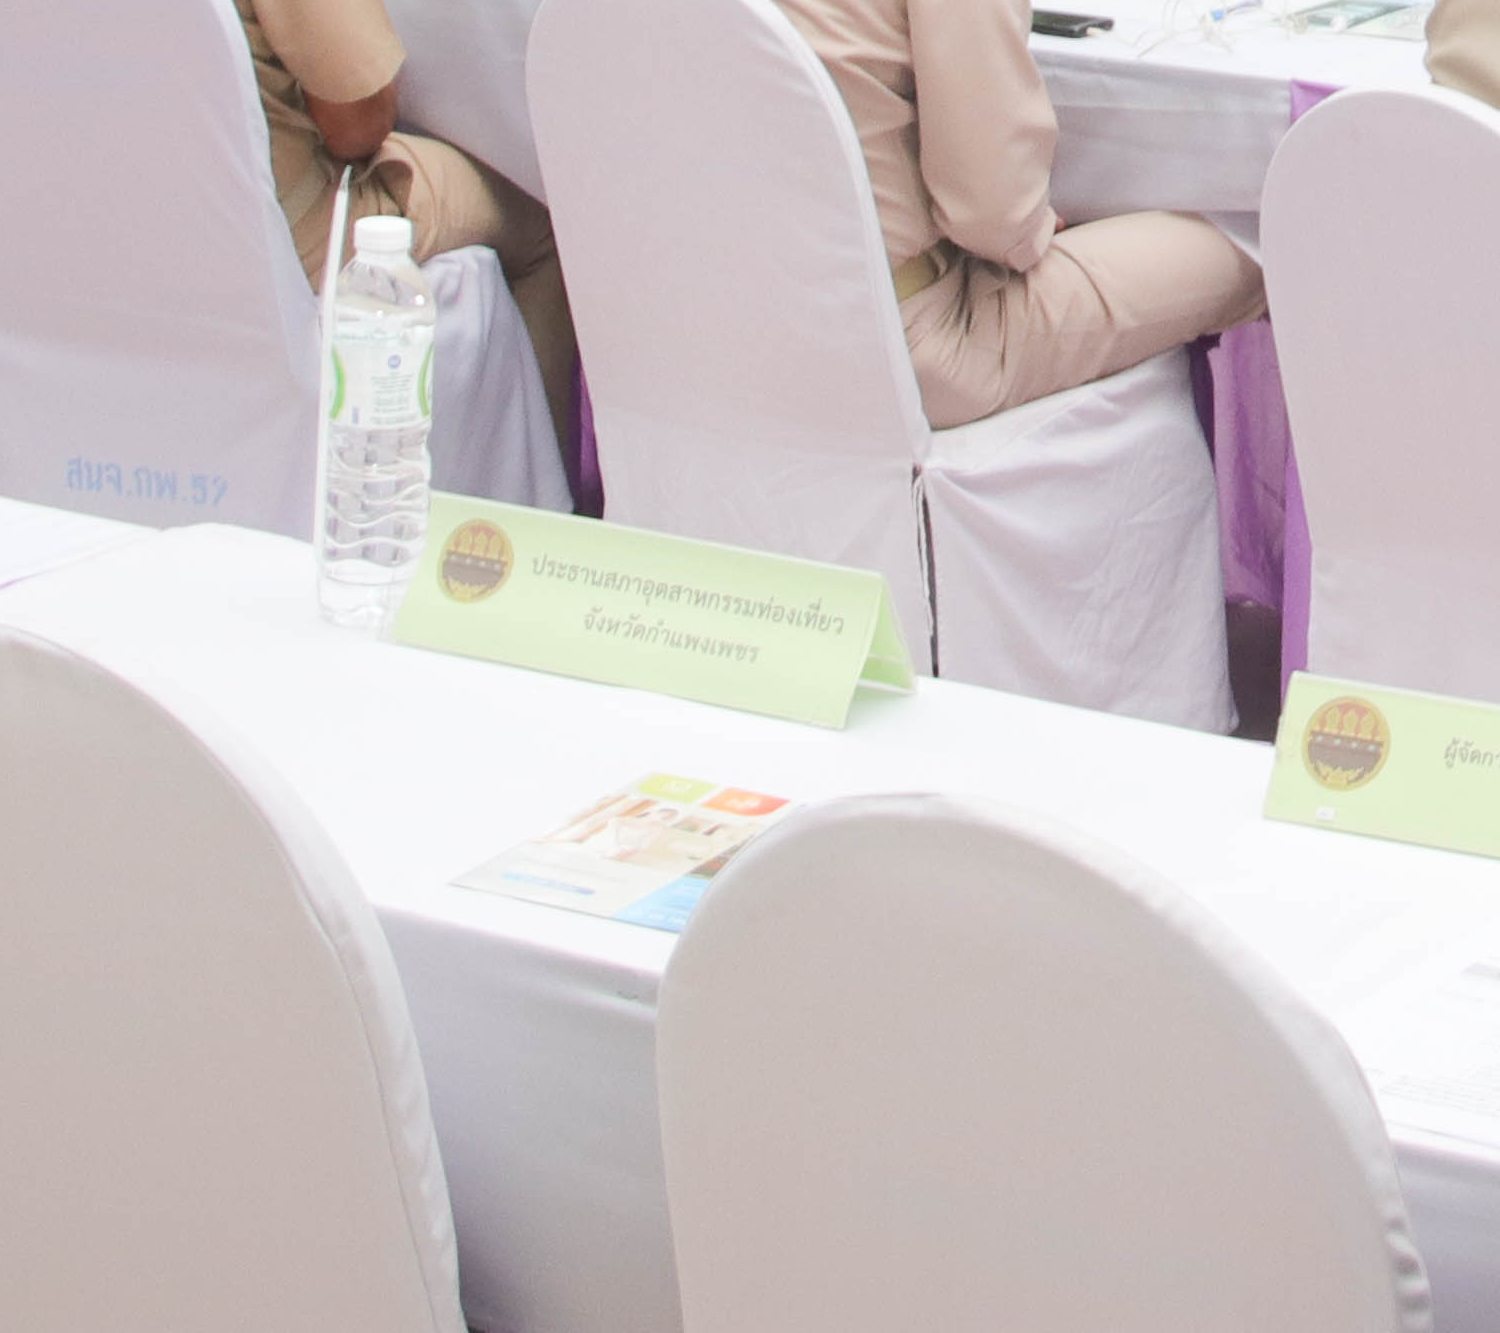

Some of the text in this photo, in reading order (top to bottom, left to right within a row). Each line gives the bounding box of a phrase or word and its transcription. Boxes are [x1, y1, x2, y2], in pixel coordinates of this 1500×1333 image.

[531, 553, 846, 635] ประธานสภาอุตสาหกรรมท่องเที่ยว
[583, 605, 761, 665] จังหวัดกำแพงเพชร
